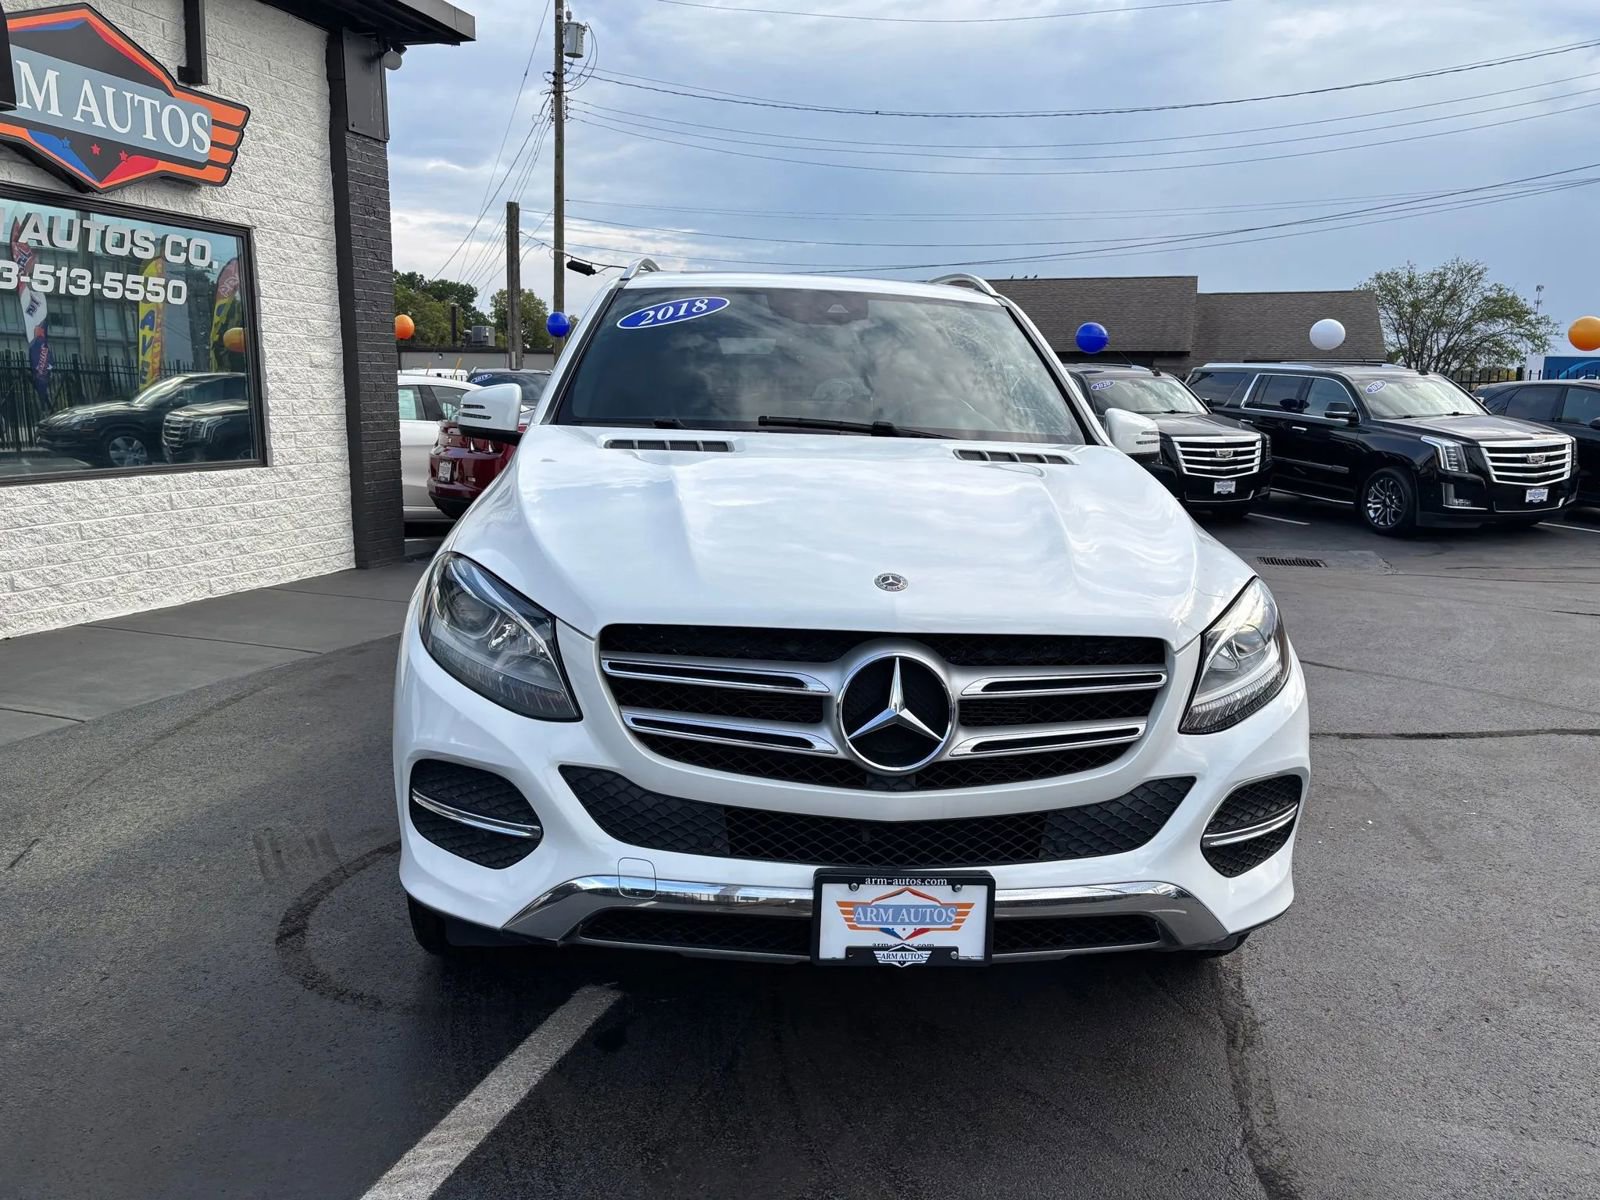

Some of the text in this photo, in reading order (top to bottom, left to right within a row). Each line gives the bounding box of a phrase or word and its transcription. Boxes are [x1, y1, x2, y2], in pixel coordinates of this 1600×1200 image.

[73, 79, 212, 154] AUTOS
[18, 211, 156, 260] AUTOS
[164, 234, 219, 270] CO.
[637, 298, 708, 326] 2018
[865, 877, 947, 886] arm-autos.com
[853, 907, 957, 924] ARM AUTOS
